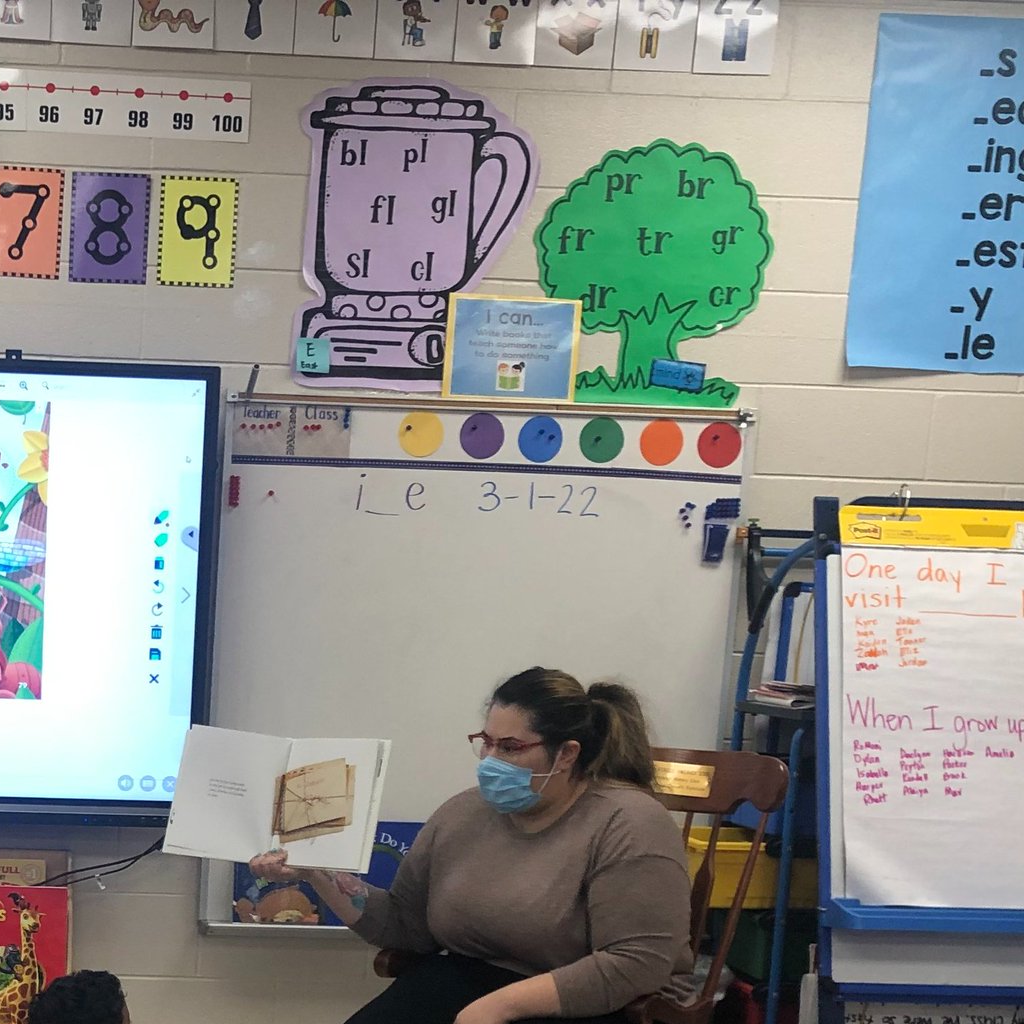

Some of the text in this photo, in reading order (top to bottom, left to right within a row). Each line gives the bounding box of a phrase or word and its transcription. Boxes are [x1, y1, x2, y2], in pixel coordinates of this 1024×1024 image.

[39, 106, 59, 123] 96
[84, 109, 104, 126] 97
[128, 111, 149, 128] 98
[172, 113, 193, 130] 99
[212, 115, 242, 133] 100
[341, 138, 426, 172] bl pl
[605, 171, 715, 201] pr br
[370, 190, 455, 225] fl gl
[0, 183, 50, 260] 7
[85, 190, 133, 265] 8
[177, 195, 221, 269] 9
[558, 226, 744, 256] fr tr gr
[346, 249, 433, 281] sl cl
[583, 284, 740, 312] dr cr
[307, 343, 315, 356] E
[497, 342, 538, 350] someone
[502, 352, 549, 361] something
[243, 405, 280, 420] Teacher
[305, 405, 338, 420] Class
[477, 480, 600, 518] 3-1-22
[845, 553, 1007, 593] One day I
[845, 585, 907, 609] visit
[846, 693, 913, 731] When
[923, 706, 943, 731] I
[953, 715, 998, 750] grow
[380, 832, 397, 847] Do
[882, 1016, 897, 1024] so
[903, 1016, 932, 1024] were
